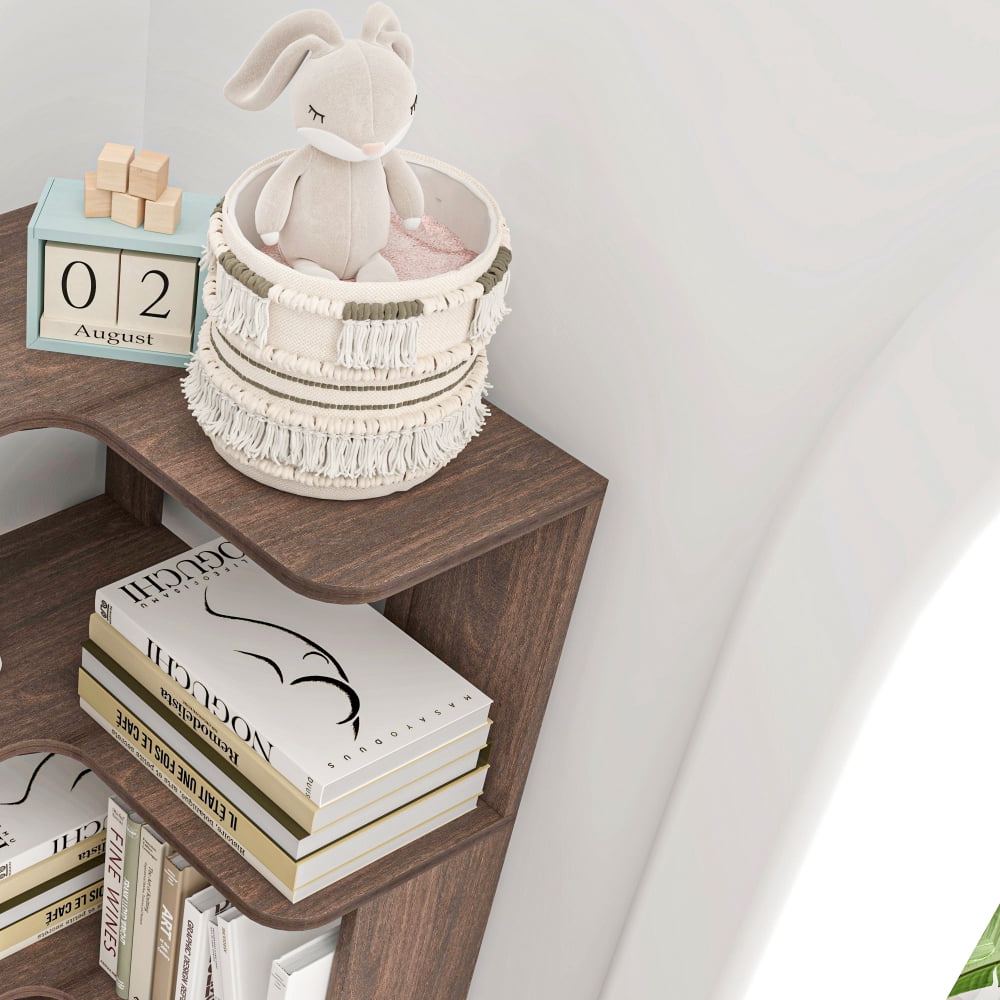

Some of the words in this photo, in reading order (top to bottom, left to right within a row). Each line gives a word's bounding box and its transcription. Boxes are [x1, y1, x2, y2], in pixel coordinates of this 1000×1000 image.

[61, 261, 97, 309] 0
[140, 269, 172, 319] 2
[74, 324, 153, 346] August
[118, 541, 246, 604] OGUCHI
[147, 637, 273, 764] NOGUCHI
[391, 694, 472, 738] MASAYO
[116, 709, 140, 741] CAFÉ
[160, 687, 240, 766] Remodelista
[141, 733, 153, 752] LE
[327, 738, 383, 769] DUUS
[155, 745, 176, 773] FOIS
[178, 769, 196, 794] UNE
[199, 790, 226, 822] ÉTAIT
[228, 814, 238, 831] IL
[107, 827, 124, 883] FINE
[45, 902, 73, 926] CAFÉ
[74, 893, 88, 908] LE
[104, 886, 120, 957] WINES
[160, 903, 174, 942] ART
[184, 919, 195, 957] GRAPHIC
[181, 954, 192, 987] DESIGN
